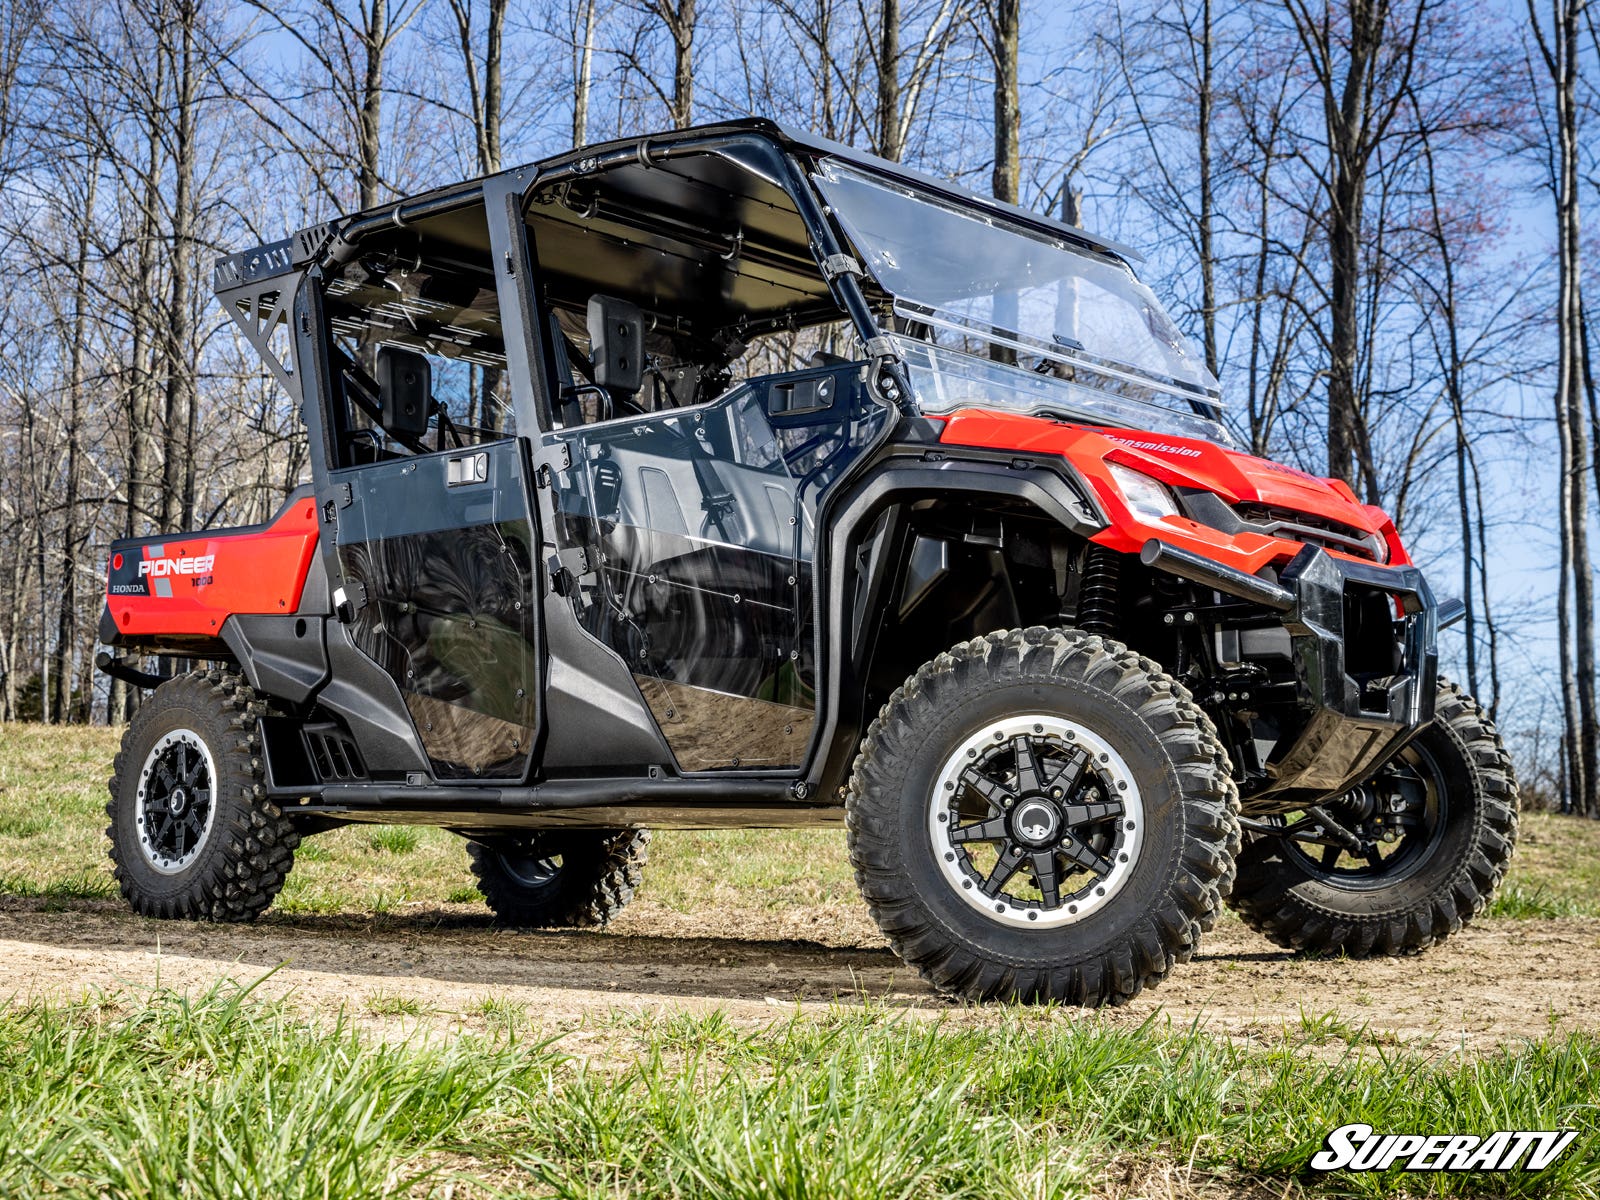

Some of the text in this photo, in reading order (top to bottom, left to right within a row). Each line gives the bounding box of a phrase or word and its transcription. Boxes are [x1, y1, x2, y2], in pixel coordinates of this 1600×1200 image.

[138, 555, 215, 577] PIONEER
[191, 576, 213, 587] 1000
[112, 585, 145, 593] HONDA
